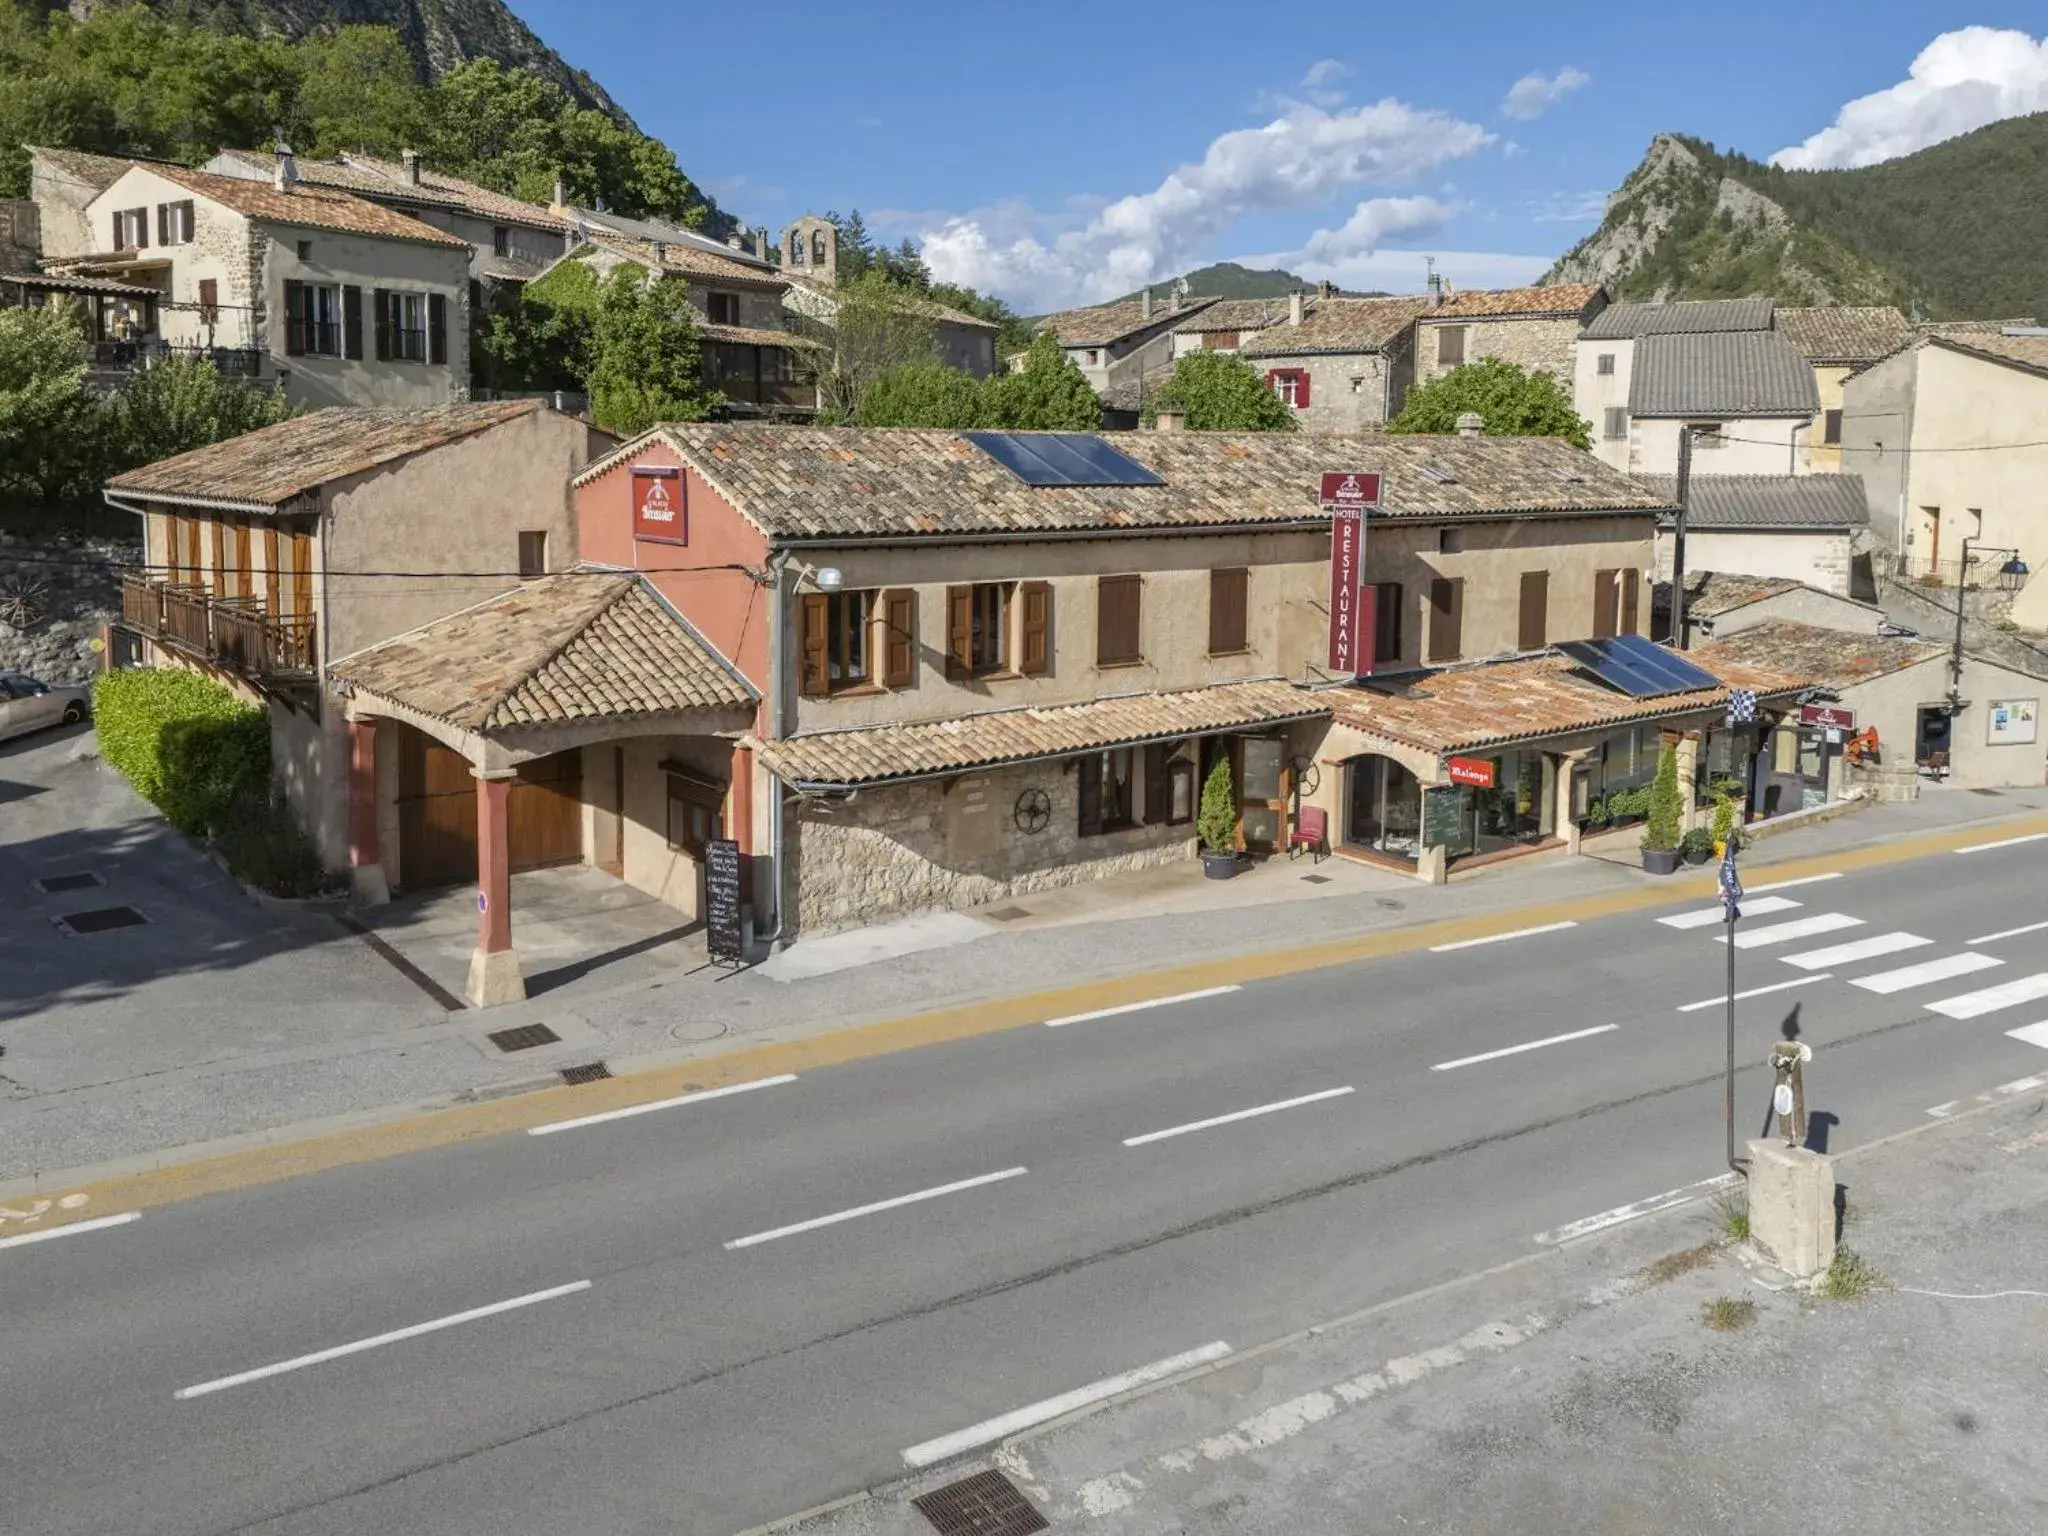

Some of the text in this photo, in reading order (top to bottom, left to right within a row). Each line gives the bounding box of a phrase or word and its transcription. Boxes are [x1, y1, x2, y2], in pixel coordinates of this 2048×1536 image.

[1336, 510, 1360, 519] HOTEL
[1337, 525, 1352, 670] RESTAURANT
[1452, 766, 1489, 783] Malongo
